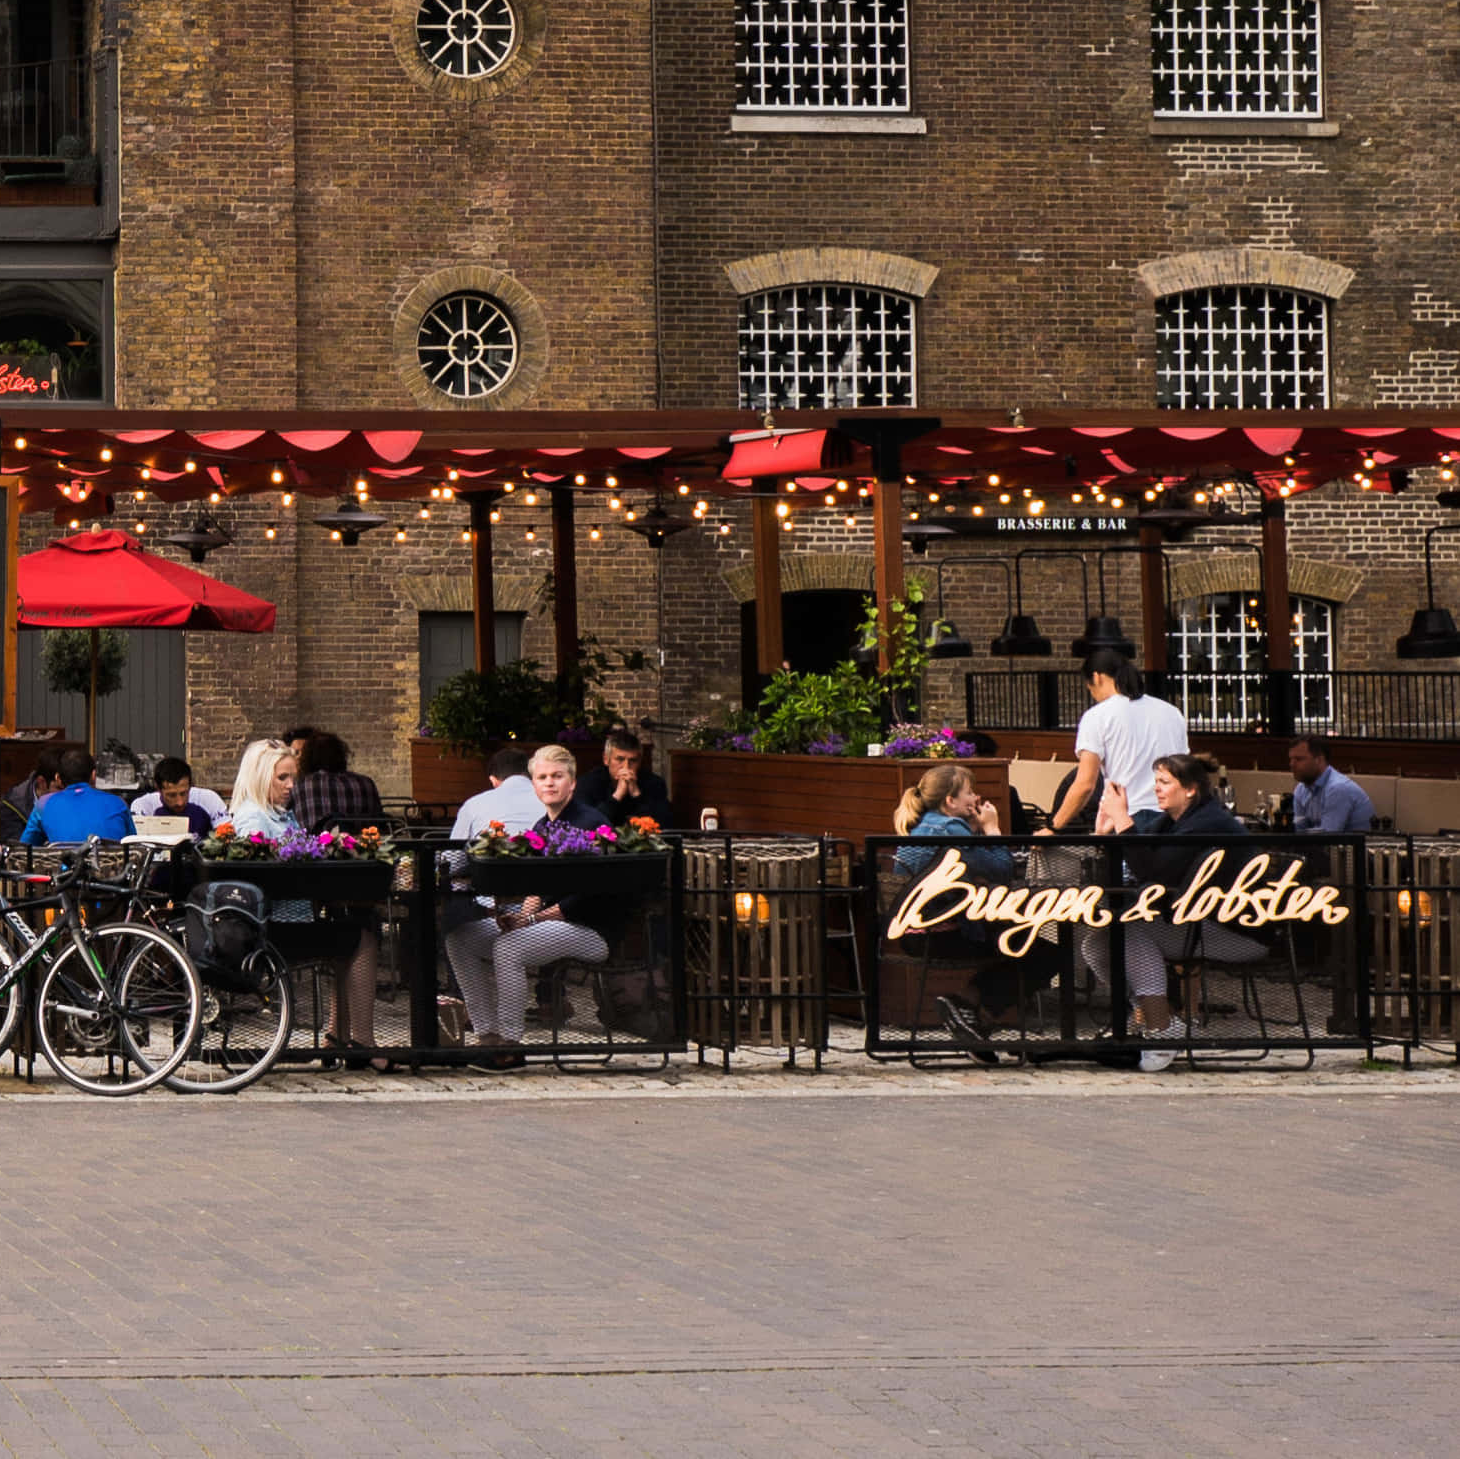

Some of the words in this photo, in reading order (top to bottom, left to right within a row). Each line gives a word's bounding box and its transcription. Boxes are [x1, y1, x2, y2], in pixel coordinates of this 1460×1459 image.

[997, 517, 1076, 530] BRASSERIE
[1081, 518, 1092, 530] &
[1098, 518, 1127, 530] BAR
[886, 847, 1113, 958] Burger
[1120, 884, 1166, 923] &
[1172, 849, 1350, 927] lobster
